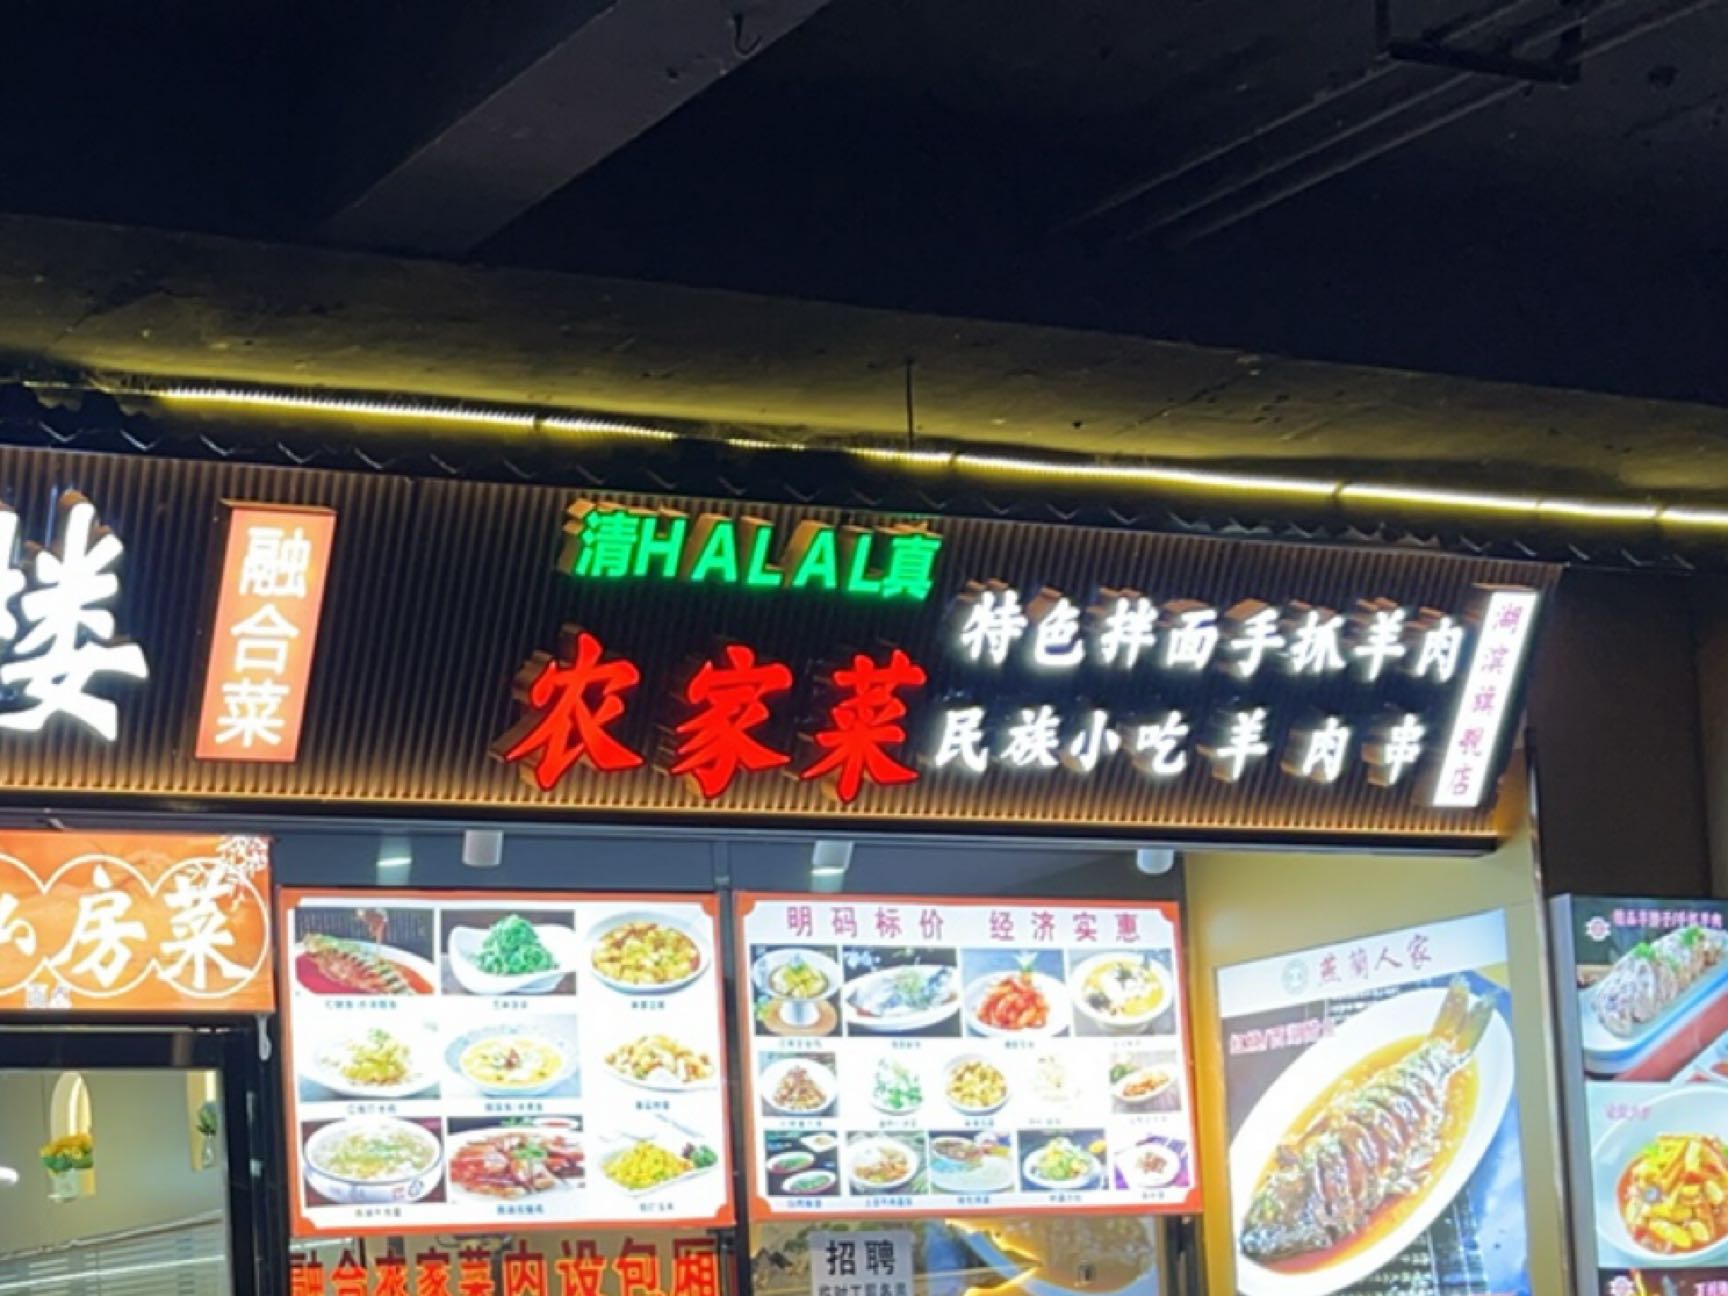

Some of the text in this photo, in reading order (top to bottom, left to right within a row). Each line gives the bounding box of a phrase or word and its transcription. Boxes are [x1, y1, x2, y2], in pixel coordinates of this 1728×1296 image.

[216, 525, 311, 750] 融合菜
[960, 590, 1466, 684] 特色拌面手抓羊肉
[504, 630, 930, 803] 农家菜
[933, 706, 1427, 787] 民族小吃羊肉串
[786, 906, 1142, 943] 明码标价 经济实惠
[825, 1239, 895, 1275] 招聘
